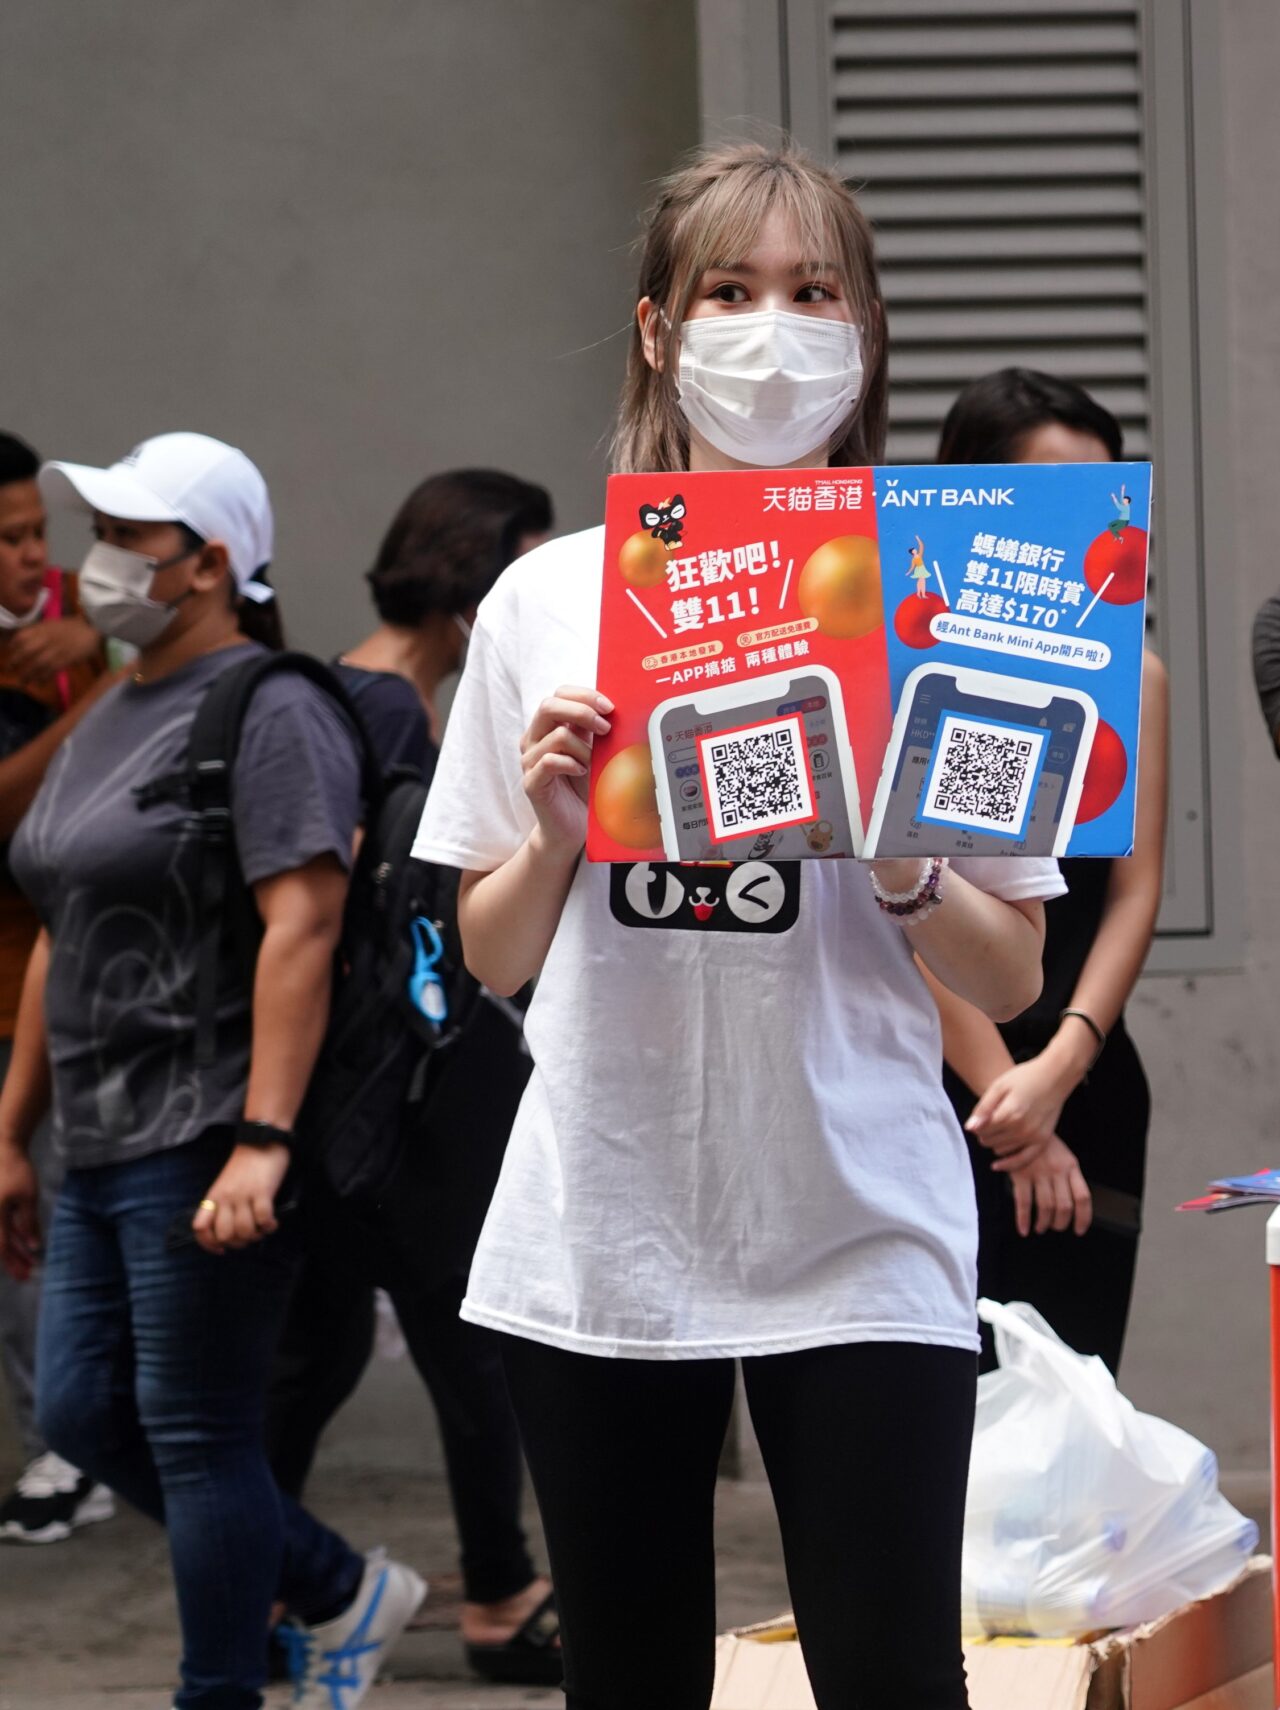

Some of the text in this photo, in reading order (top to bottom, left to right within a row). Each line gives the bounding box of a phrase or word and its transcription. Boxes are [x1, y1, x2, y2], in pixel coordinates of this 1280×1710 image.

[763, 486, 862, 512] 天貓香港
[941, 488, 1015, 506] BANK
[665, 540, 781, 592] 狂歡吧!
[970, 532, 1066, 572] 螞蟻銀行
[963, 559, 1085, 607] 雙11限時賞
[670, 587, 760, 634] 雙11!
[973, 627, 1004, 644] Bank
[1007, 633, 1033, 649] Mini
